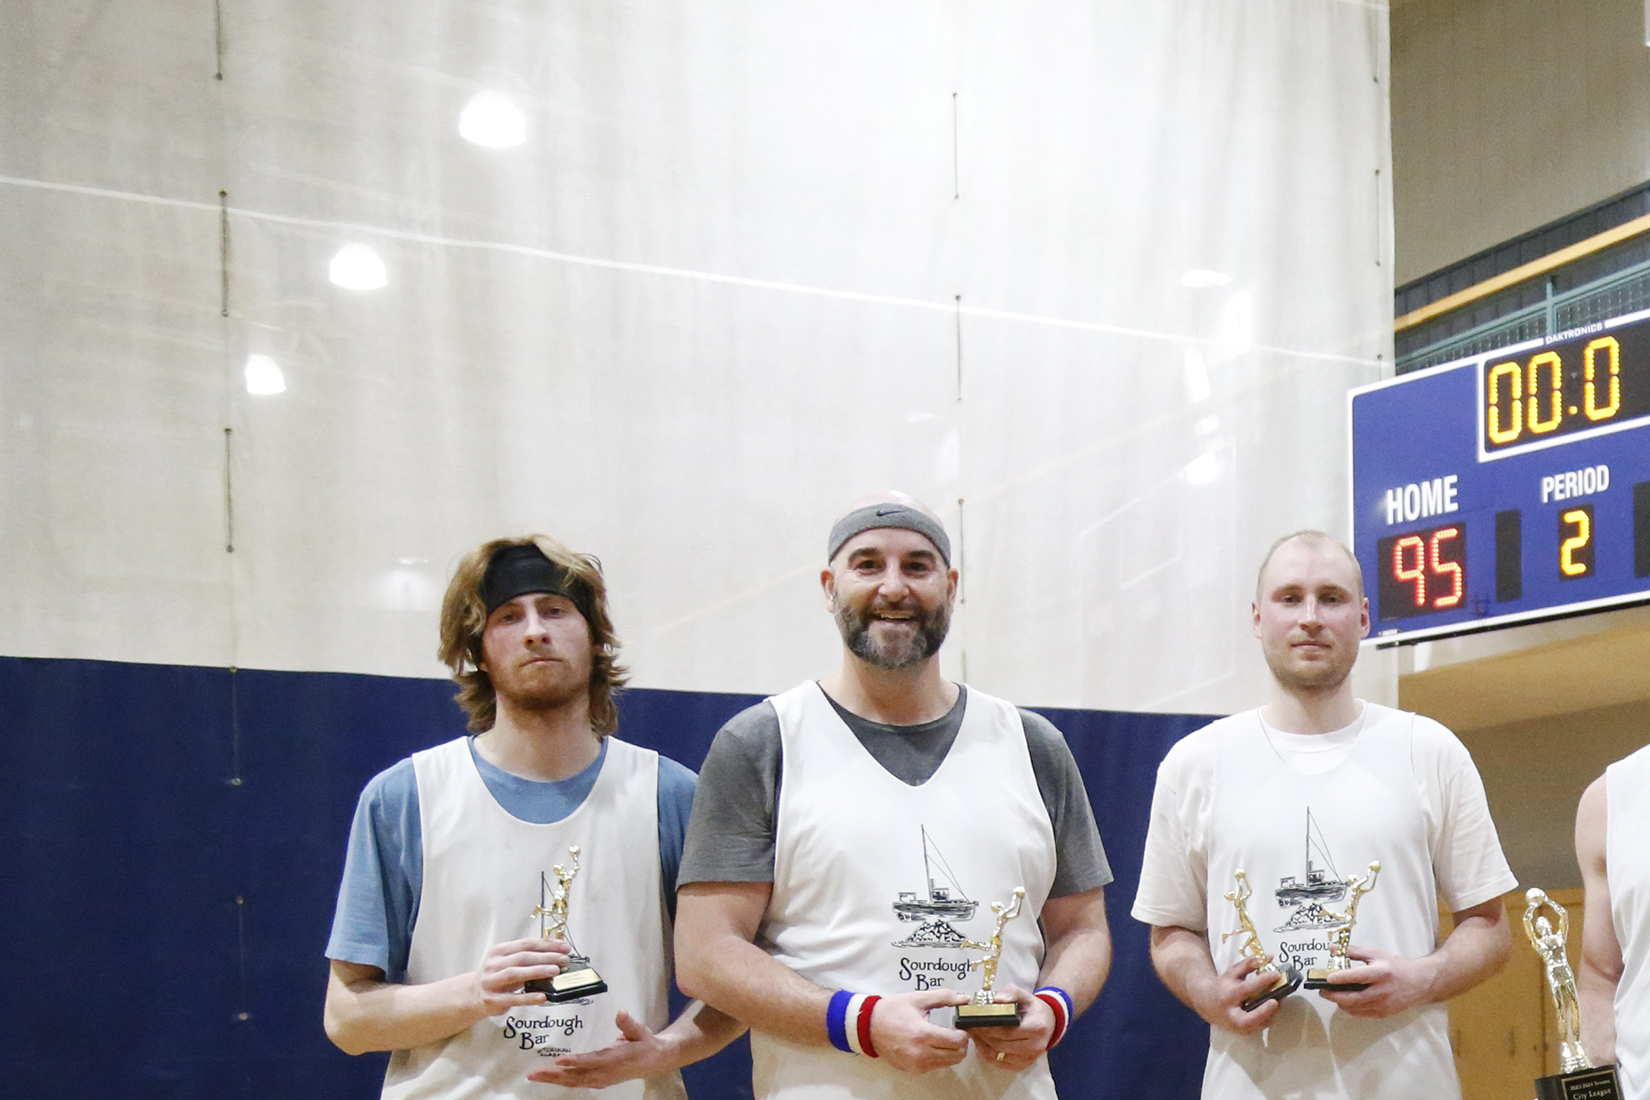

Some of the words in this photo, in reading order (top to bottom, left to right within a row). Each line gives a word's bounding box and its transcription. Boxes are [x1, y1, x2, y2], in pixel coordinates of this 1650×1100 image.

[1545, 323, 1603, 344] DAKTRONICS
[1488, 336, 1620, 443] 00.0
[1541, 465, 1610, 503] PERIOD
[1386, 475, 1459, 525] HOME
[1561, 510, 1590, 576] 2
[1395, 527, 1463, 606] 95
[1279, 938, 1337, 963] Sourdou
[1291, 955, 1317, 971] Bar
[915, 974, 944, 991] Bar
[503, 1015, 583, 1039] Sourdough
[519, 1032, 549, 1050] Bar
[1573, 1093, 1587, 1100] City
[1589, 1089, 1611, 1098] League
